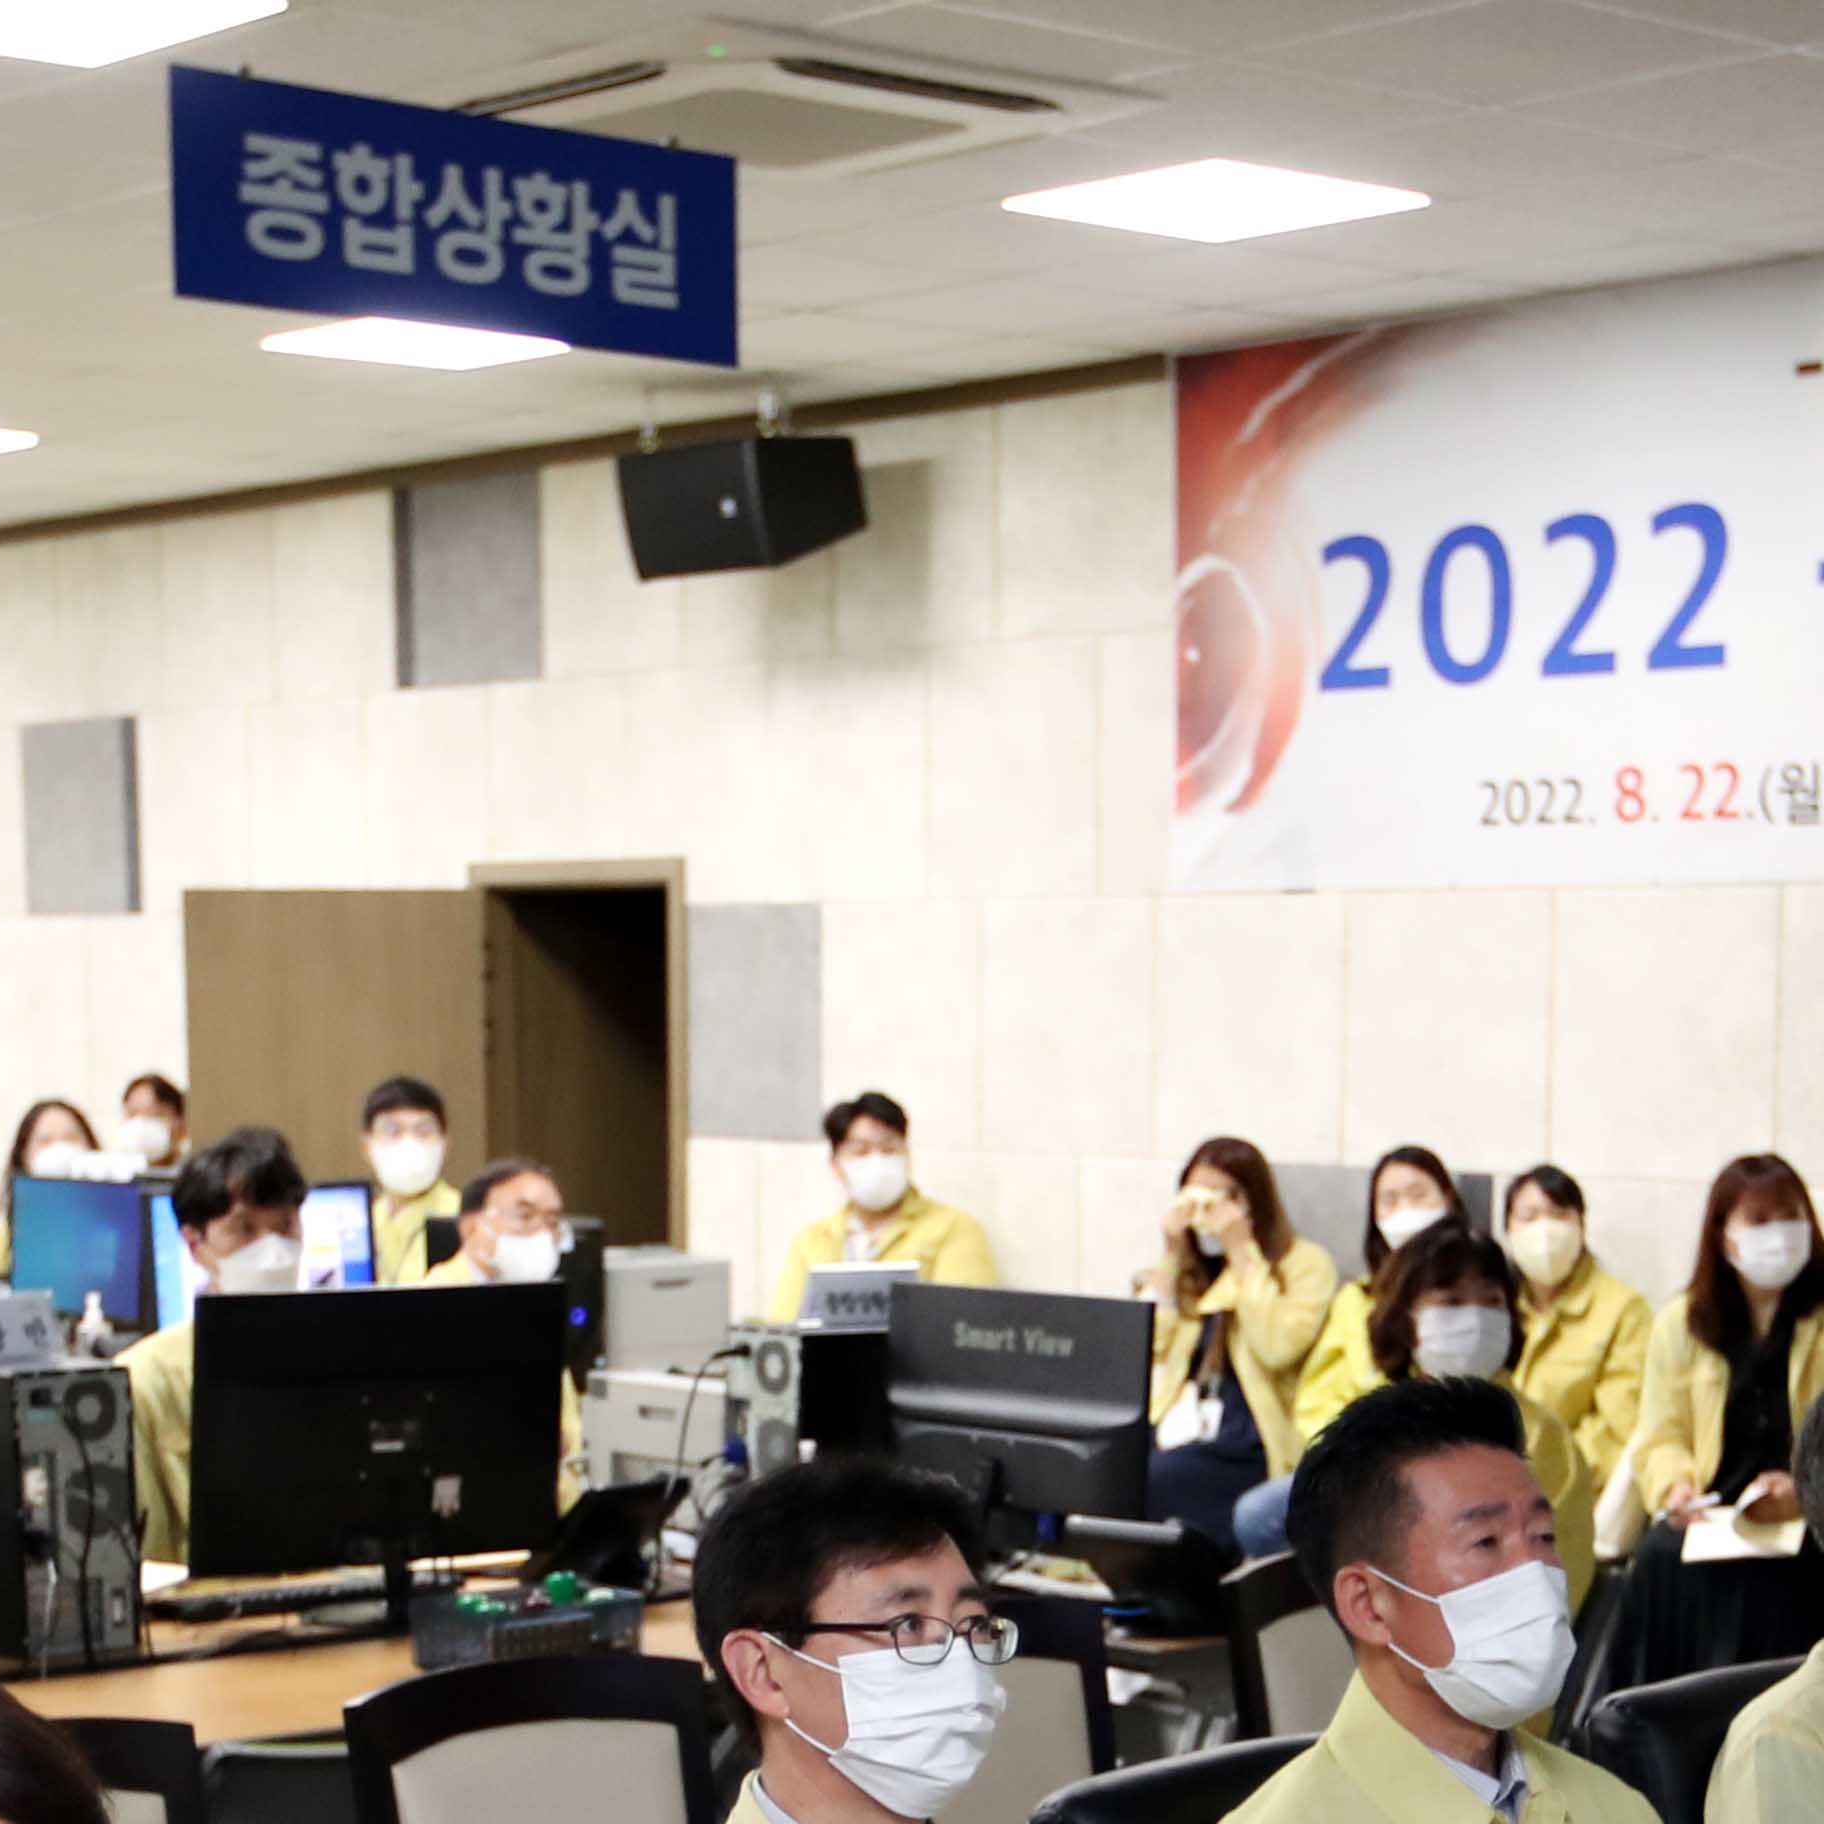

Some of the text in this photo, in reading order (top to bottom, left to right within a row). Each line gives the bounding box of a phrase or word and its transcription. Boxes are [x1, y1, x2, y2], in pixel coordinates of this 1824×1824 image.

[237, 132, 681, 310] 종합상황실
[1318, 502, 1729, 693] 2022
[1478, 778, 1597, 826] 2022.
[953, 1319, 1075, 1358] Smart View
